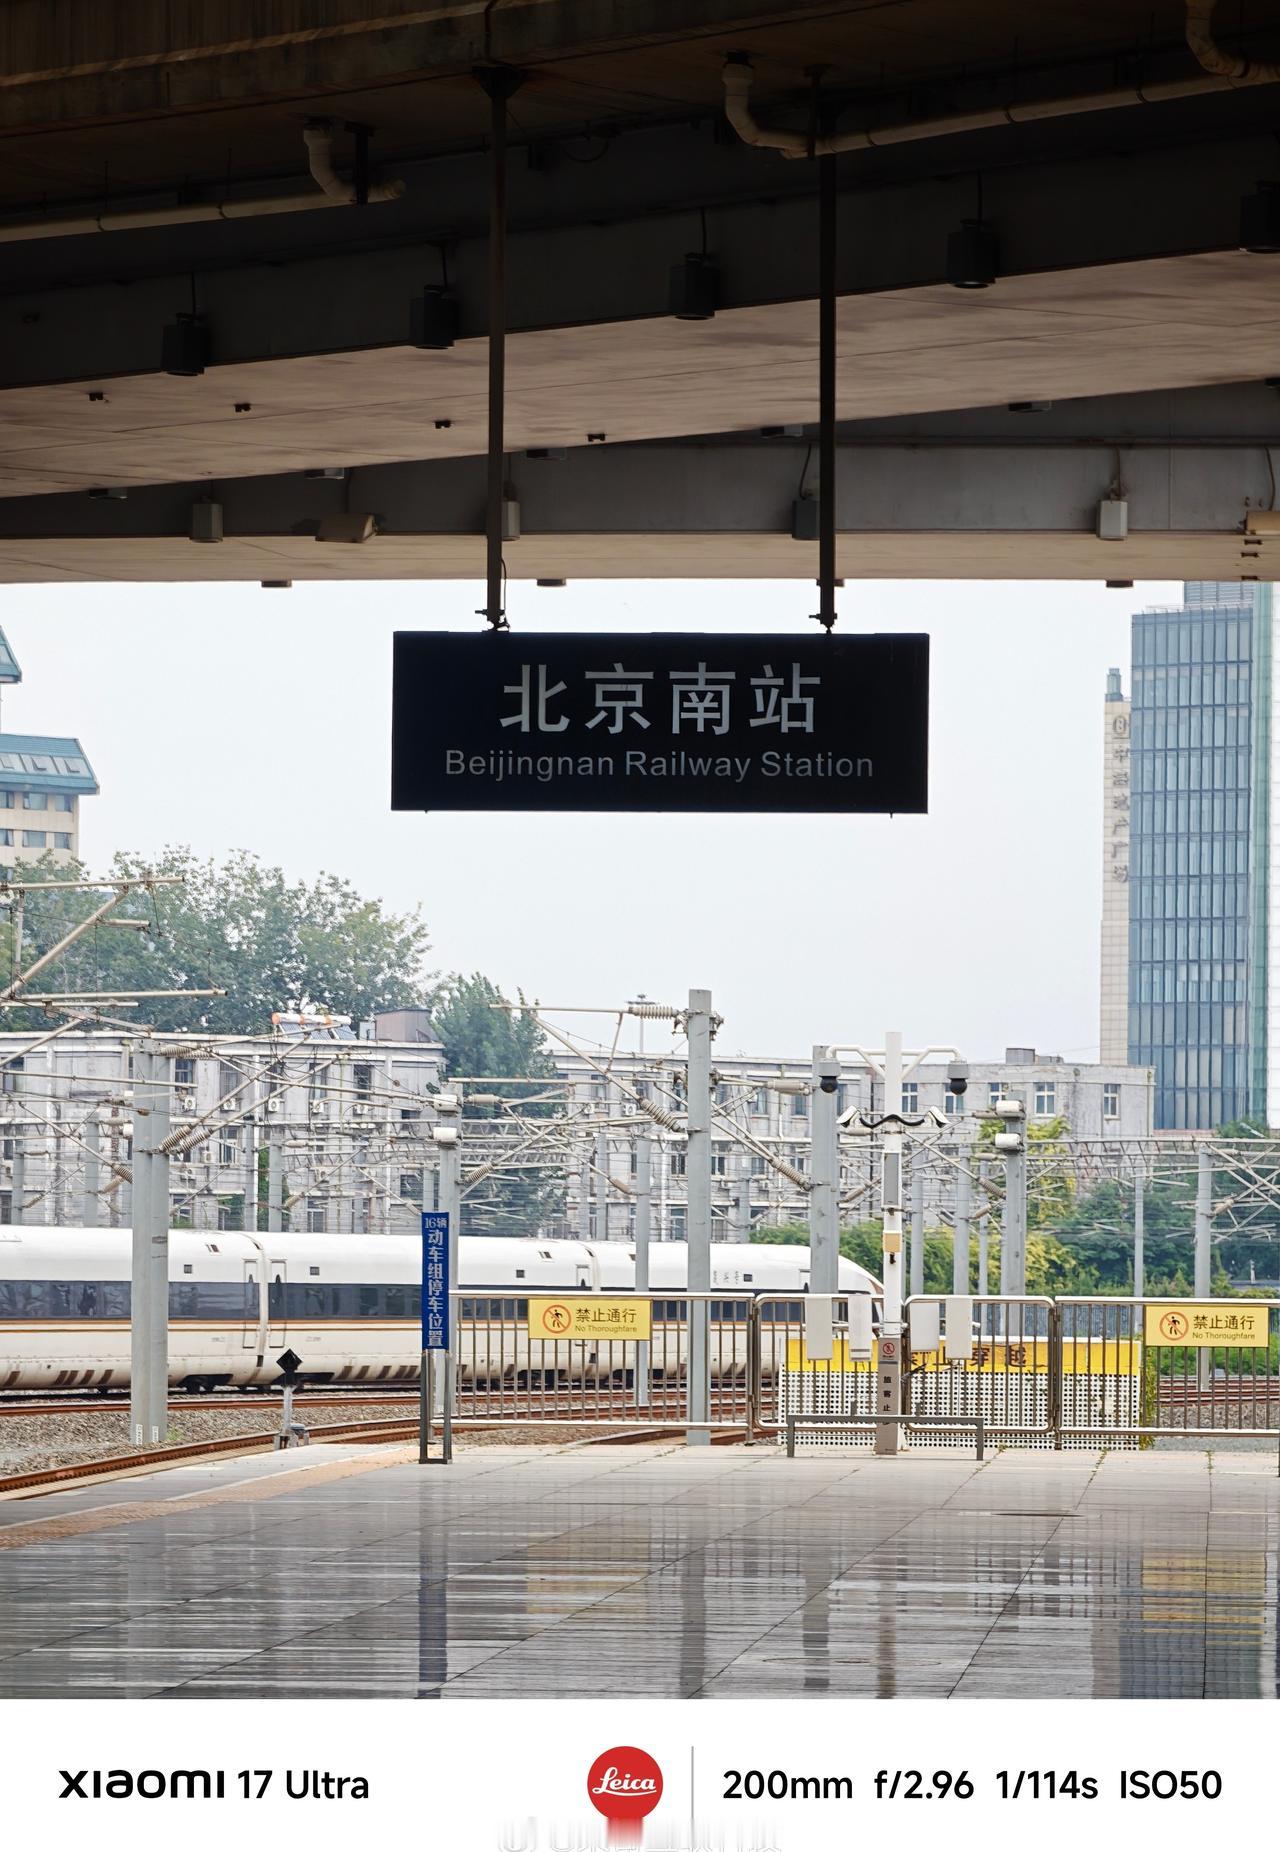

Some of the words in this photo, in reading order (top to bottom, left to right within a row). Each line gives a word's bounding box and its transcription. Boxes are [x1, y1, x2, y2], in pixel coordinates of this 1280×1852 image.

[500, 662, 821, 735] 北京南站
[445, 749, 613, 782] Beijingnan
[625, 750, 751, 783] Railway
[760, 750, 873, 778] Station
[424, 1217, 447, 1229] 16辆
[427, 1229, 444, 1347] 动车组停车位置
[576, 1307, 637, 1323] 禁止通行
[1193, 1314, 1255, 1330] 禁止通行
[588, 1325, 638, 1334] Thoroughfare
[1205, 1331, 1255, 1340] Thoroughfare
